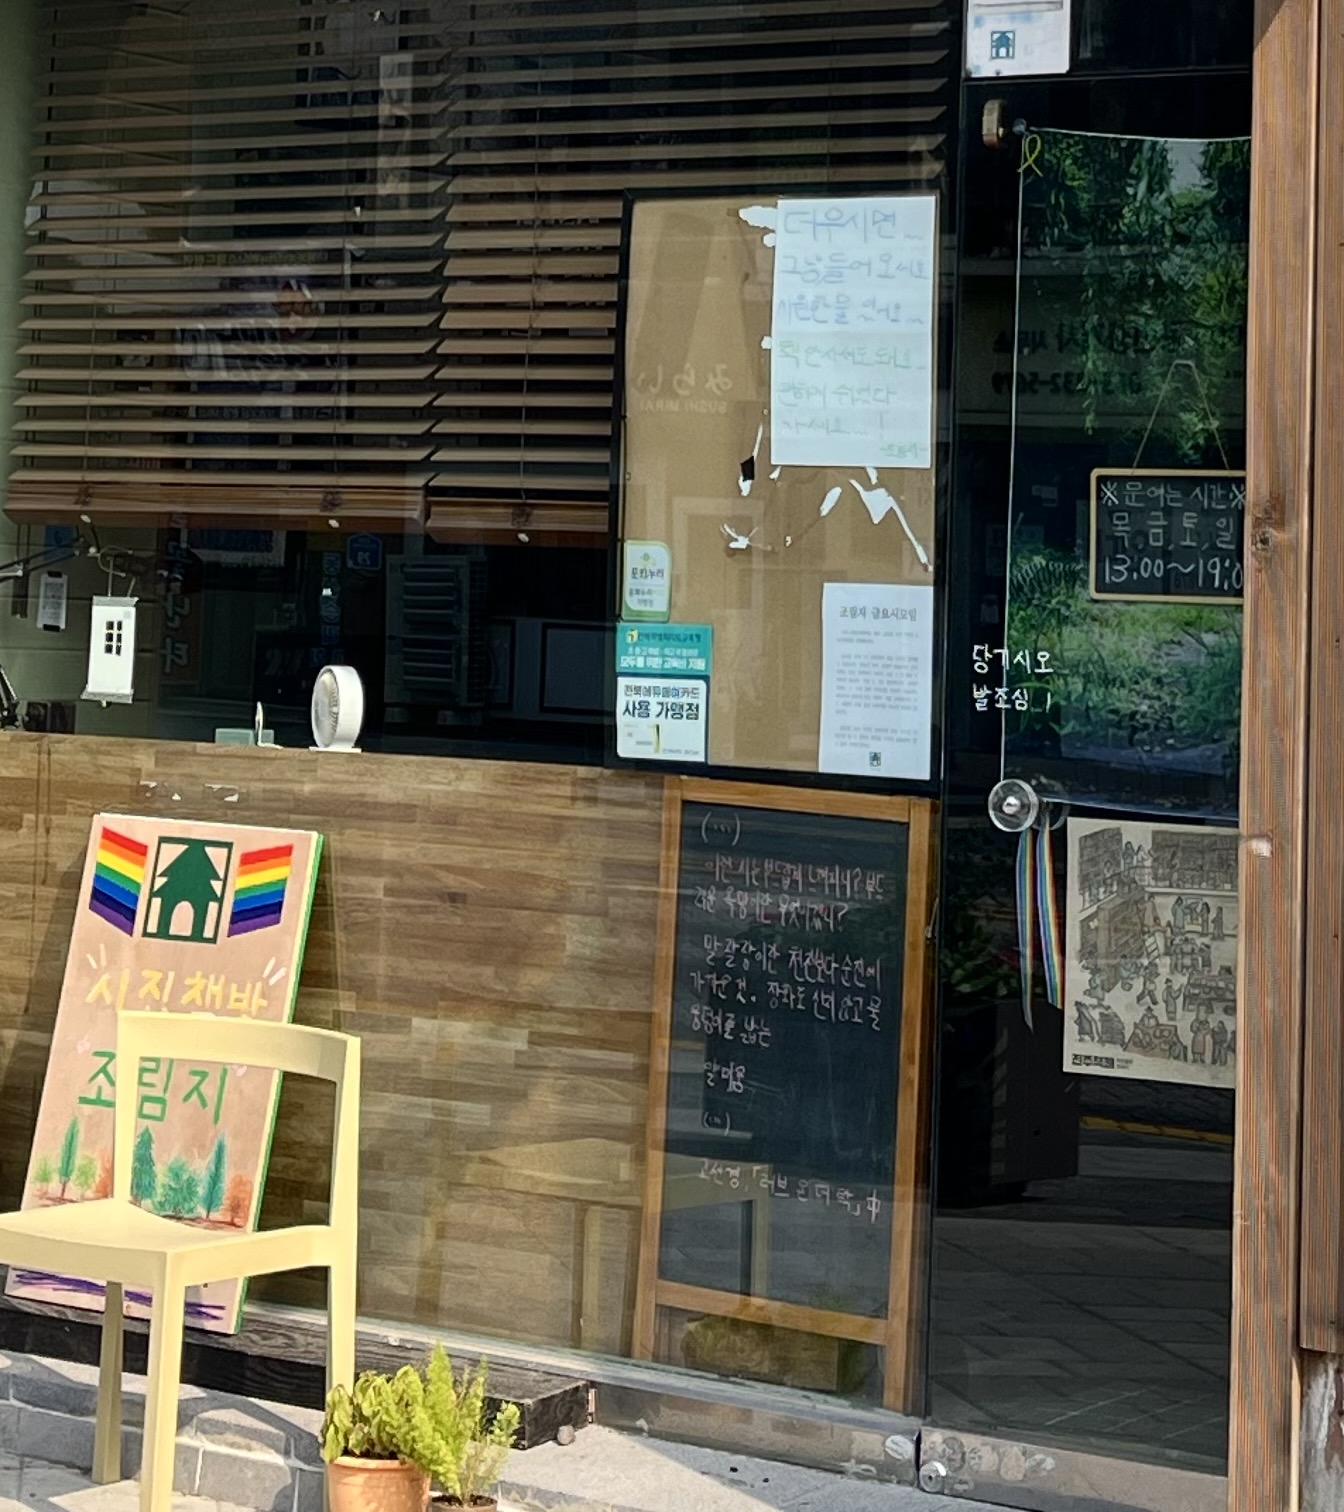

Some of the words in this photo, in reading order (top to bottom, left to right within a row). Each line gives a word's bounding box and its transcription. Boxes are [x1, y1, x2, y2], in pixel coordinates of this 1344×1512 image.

[973, 643, 1054, 674] 당기시오
[622, 699, 650, 719] 사용
[656, 701, 700, 721] 가맹점
[77, 1050, 229, 1126] 조림지
